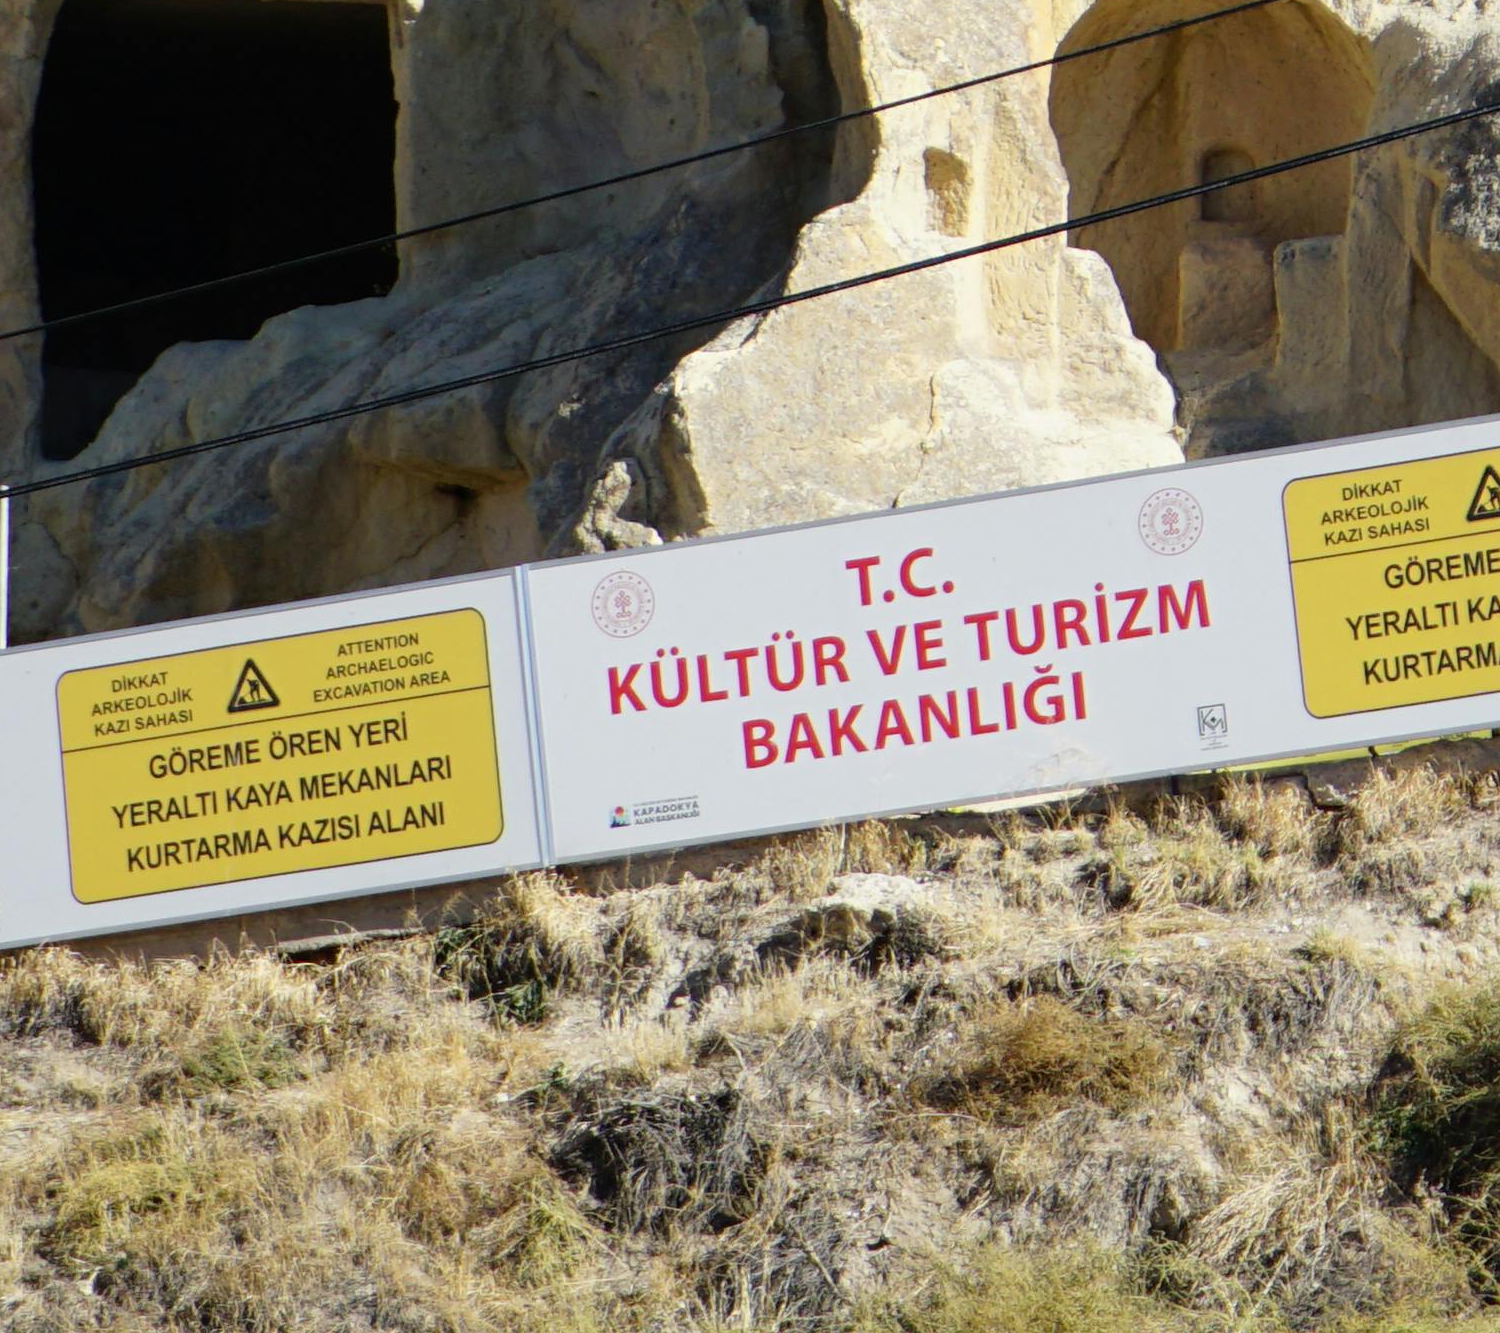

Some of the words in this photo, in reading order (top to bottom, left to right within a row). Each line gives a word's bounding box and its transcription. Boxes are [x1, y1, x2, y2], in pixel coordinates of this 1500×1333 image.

[1342, 479, 1401, 501] DİKKAT
[1321, 496, 1429, 525] ARKEOLOJİK
[1325, 529, 1362, 546] KAZI
[1368, 517, 1429, 539] SAHASI
[845, 548, 954, 605] T.C.
[1345, 601, 1458, 641] YERALTI
[337, 633, 418, 656] ATTENTION
[609, 629, 850, 715] KÜLTÜR
[867, 620, 947, 675] VE
[964, 580, 1211, 661] TURİZM
[326, 651, 433, 679] ARCHAELOGIC
[111, 671, 167, 692] DİKKAT
[313, 677, 405, 702] EXCAVATION
[409, 670, 450, 687] AREA
[91, 688, 192, 716] ARKEOLOJİK
[743, 665, 1086, 768] BAKANLIĞI
[94, 719, 129, 736] KAZI
[135, 709, 192, 730] SAHASI
[149, 739, 261, 778] GÖREME
[269, 727, 341, 759] ÖREN
[347, 711, 407, 747] YERİ
[111, 790, 217, 828] YERALTI
[226, 780, 292, 811] KAYA
[299, 754, 451, 800] MEKANLARI
[127, 828, 271, 872] KURTARMA
[278, 814, 360, 848] KAZISI
[368, 801, 444, 836] ALANI
